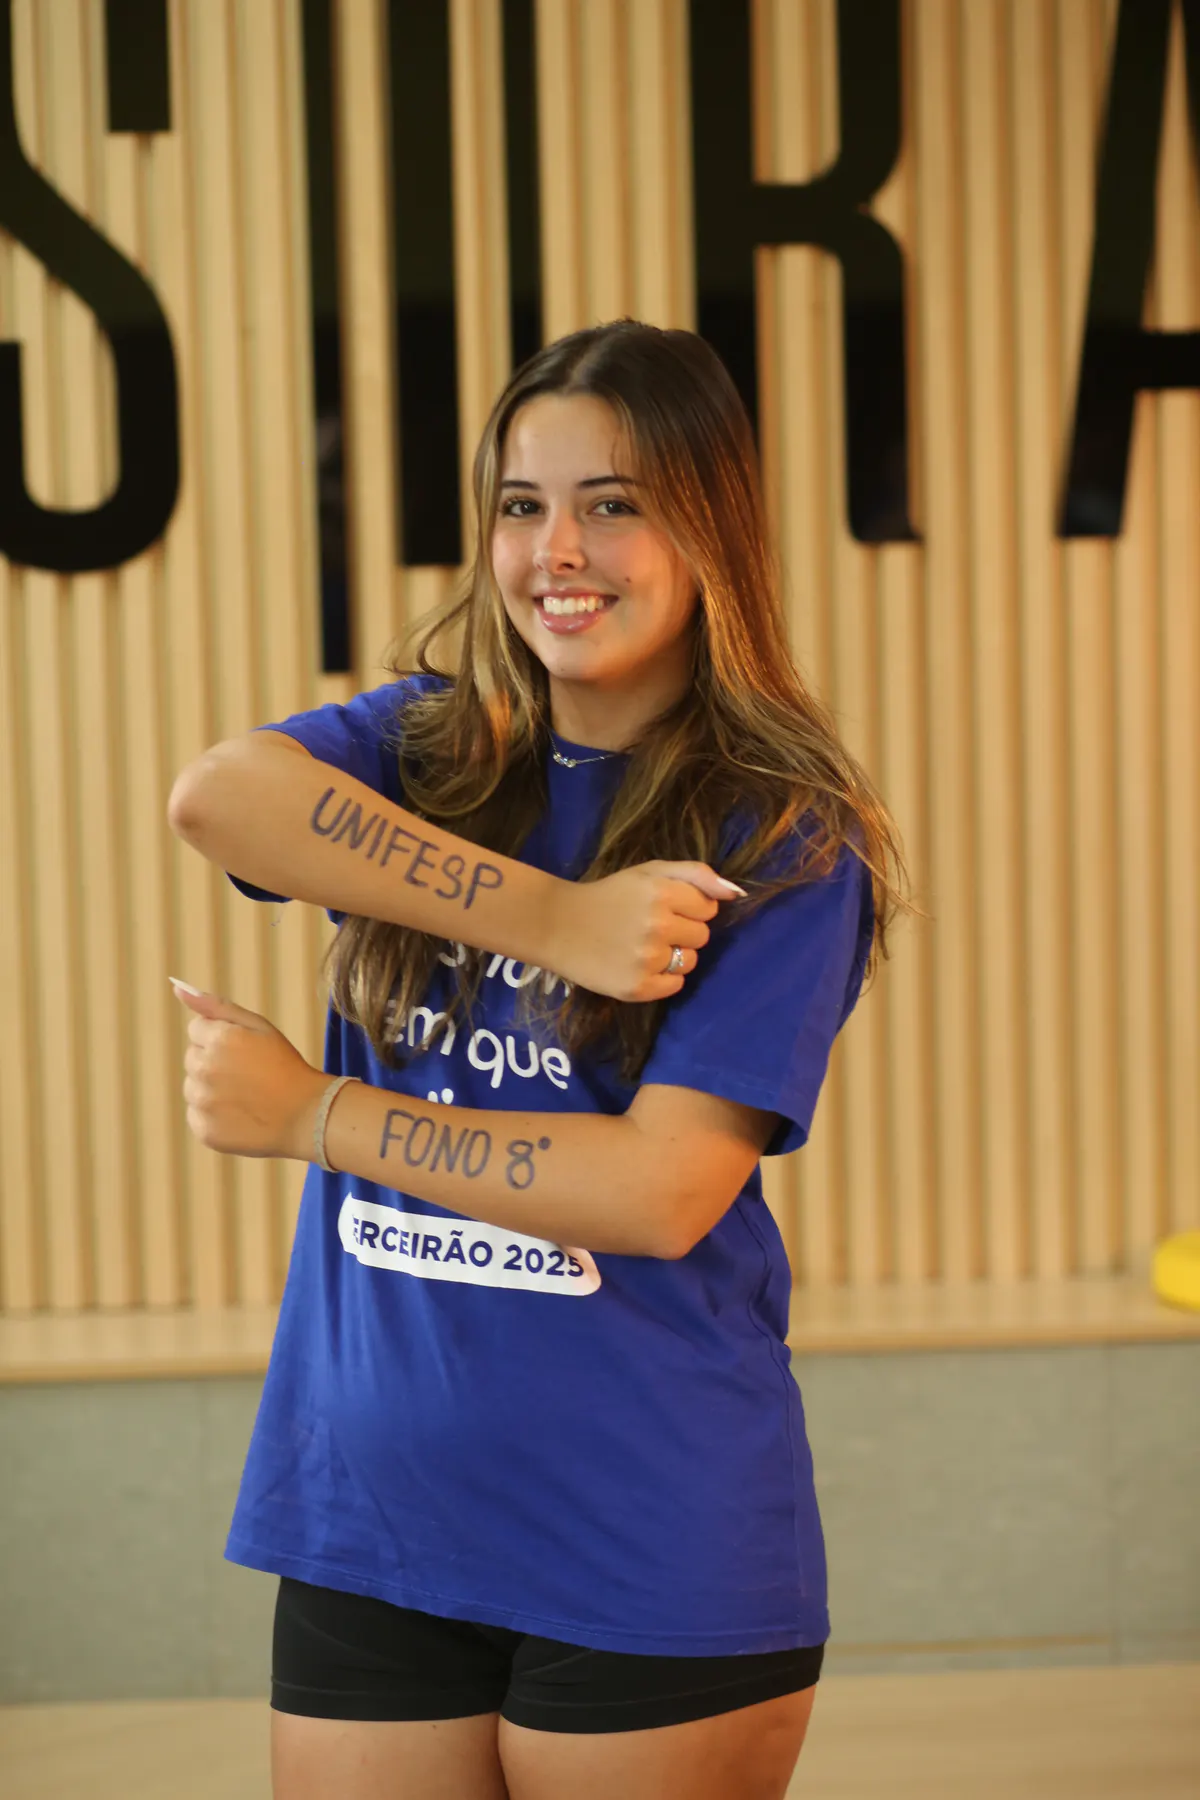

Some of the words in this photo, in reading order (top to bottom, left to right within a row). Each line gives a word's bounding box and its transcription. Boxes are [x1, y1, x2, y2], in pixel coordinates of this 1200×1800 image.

[310, 787, 504, 910] UNIFESP
[467, 1028, 571, 1090] que
[379, 1108, 492, 1178] FONO
[503, 1244, 585, 1278] 2025
